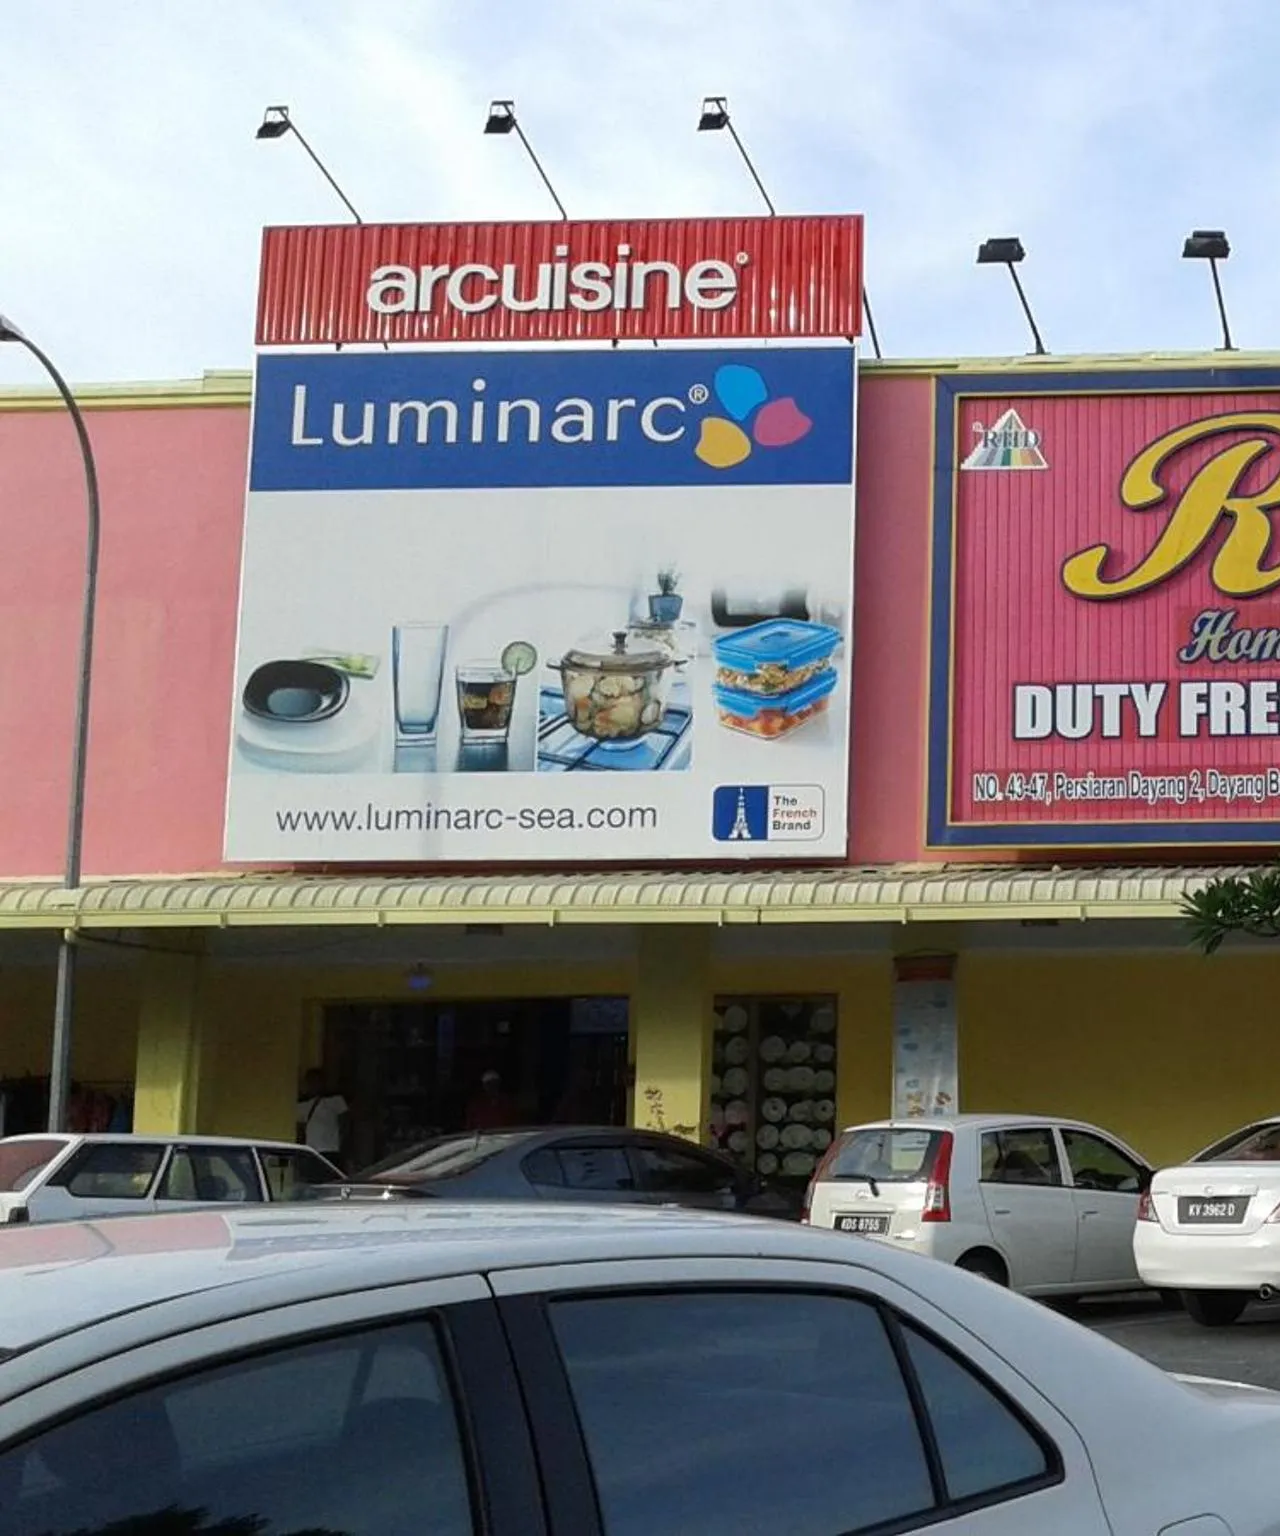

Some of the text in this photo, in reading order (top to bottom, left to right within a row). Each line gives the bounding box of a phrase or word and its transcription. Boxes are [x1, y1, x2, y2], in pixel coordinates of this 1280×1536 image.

[1013, 681, 1167, 741] DUTY
[1054, 771, 1126, 799] Persiaran
[1128, 769, 1187, 804] Dayang
[1189, 769, 1206, 803] 2,
[1207, 768, 1265, 802] Dayang
[773, 795, 798, 806] The
[276, 802, 657, 834] www.luminarc-sea.com
[772, 808, 817, 818] French
[772, 820, 811, 831] Brand
[1188, 1203, 1202, 1217] KV
